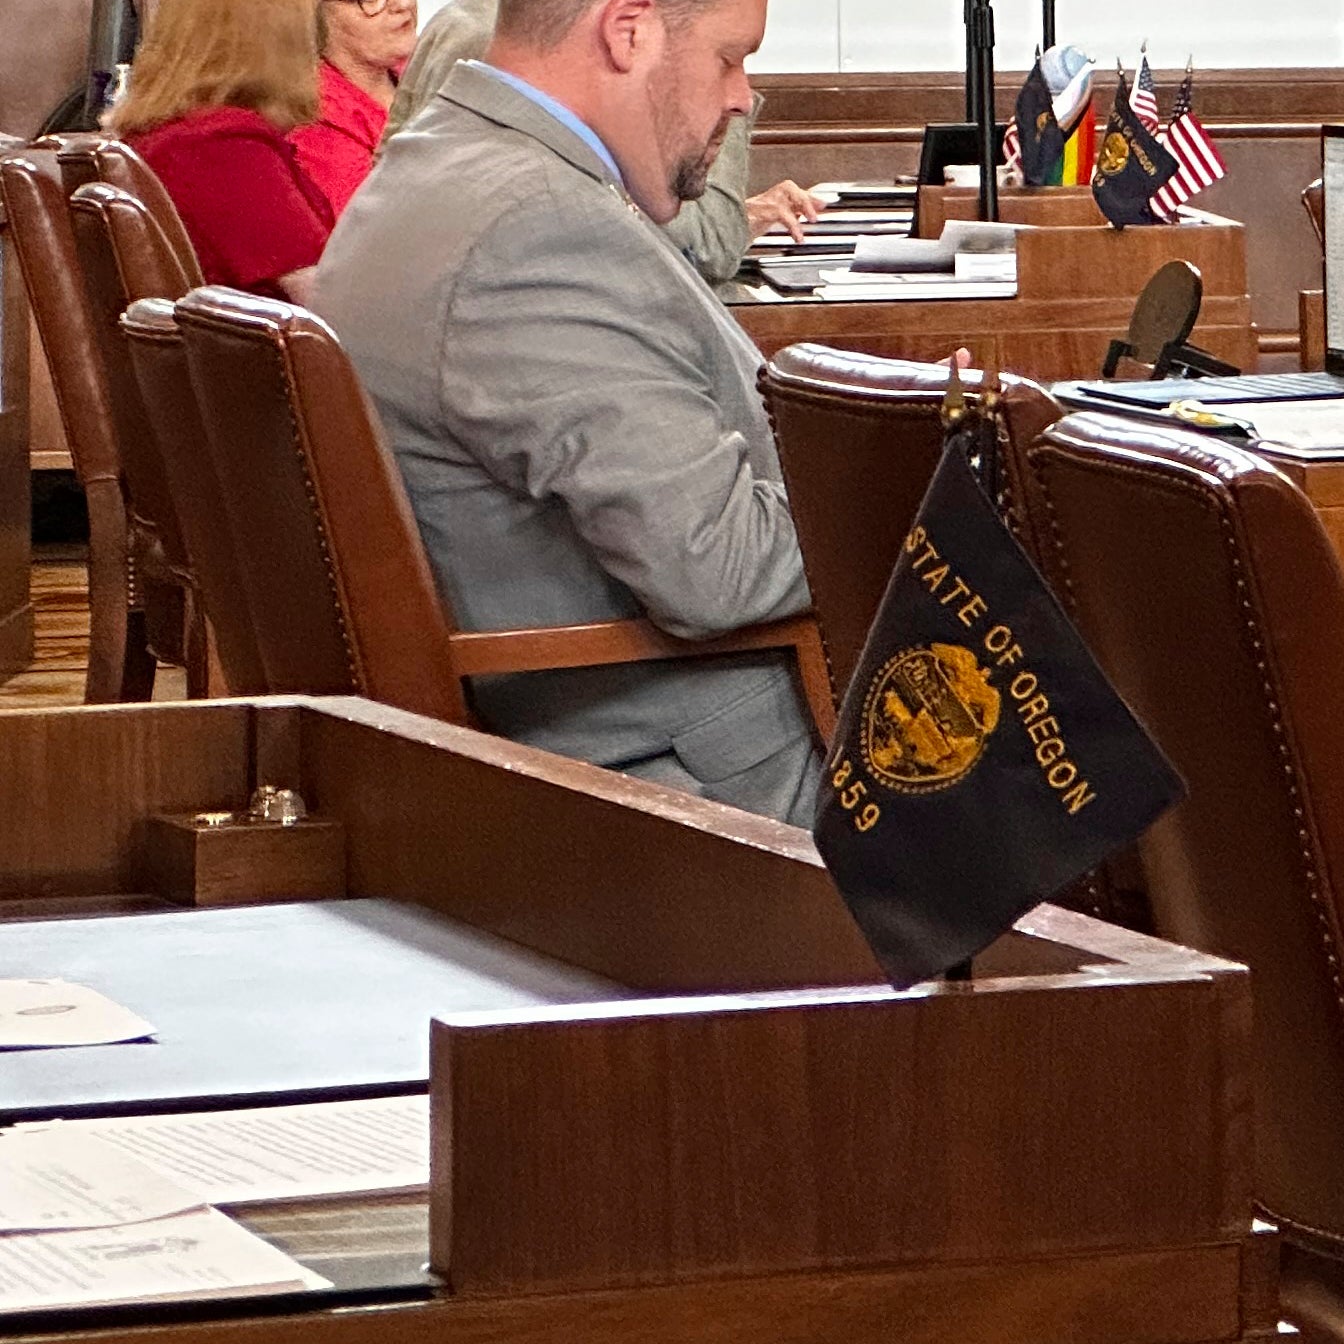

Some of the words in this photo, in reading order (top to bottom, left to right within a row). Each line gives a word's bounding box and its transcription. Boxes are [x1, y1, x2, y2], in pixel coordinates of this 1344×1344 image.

[904, 525, 988, 627] STATE
[984, 624, 1023, 666] OF
[1010, 672, 1098, 815] OREGON
